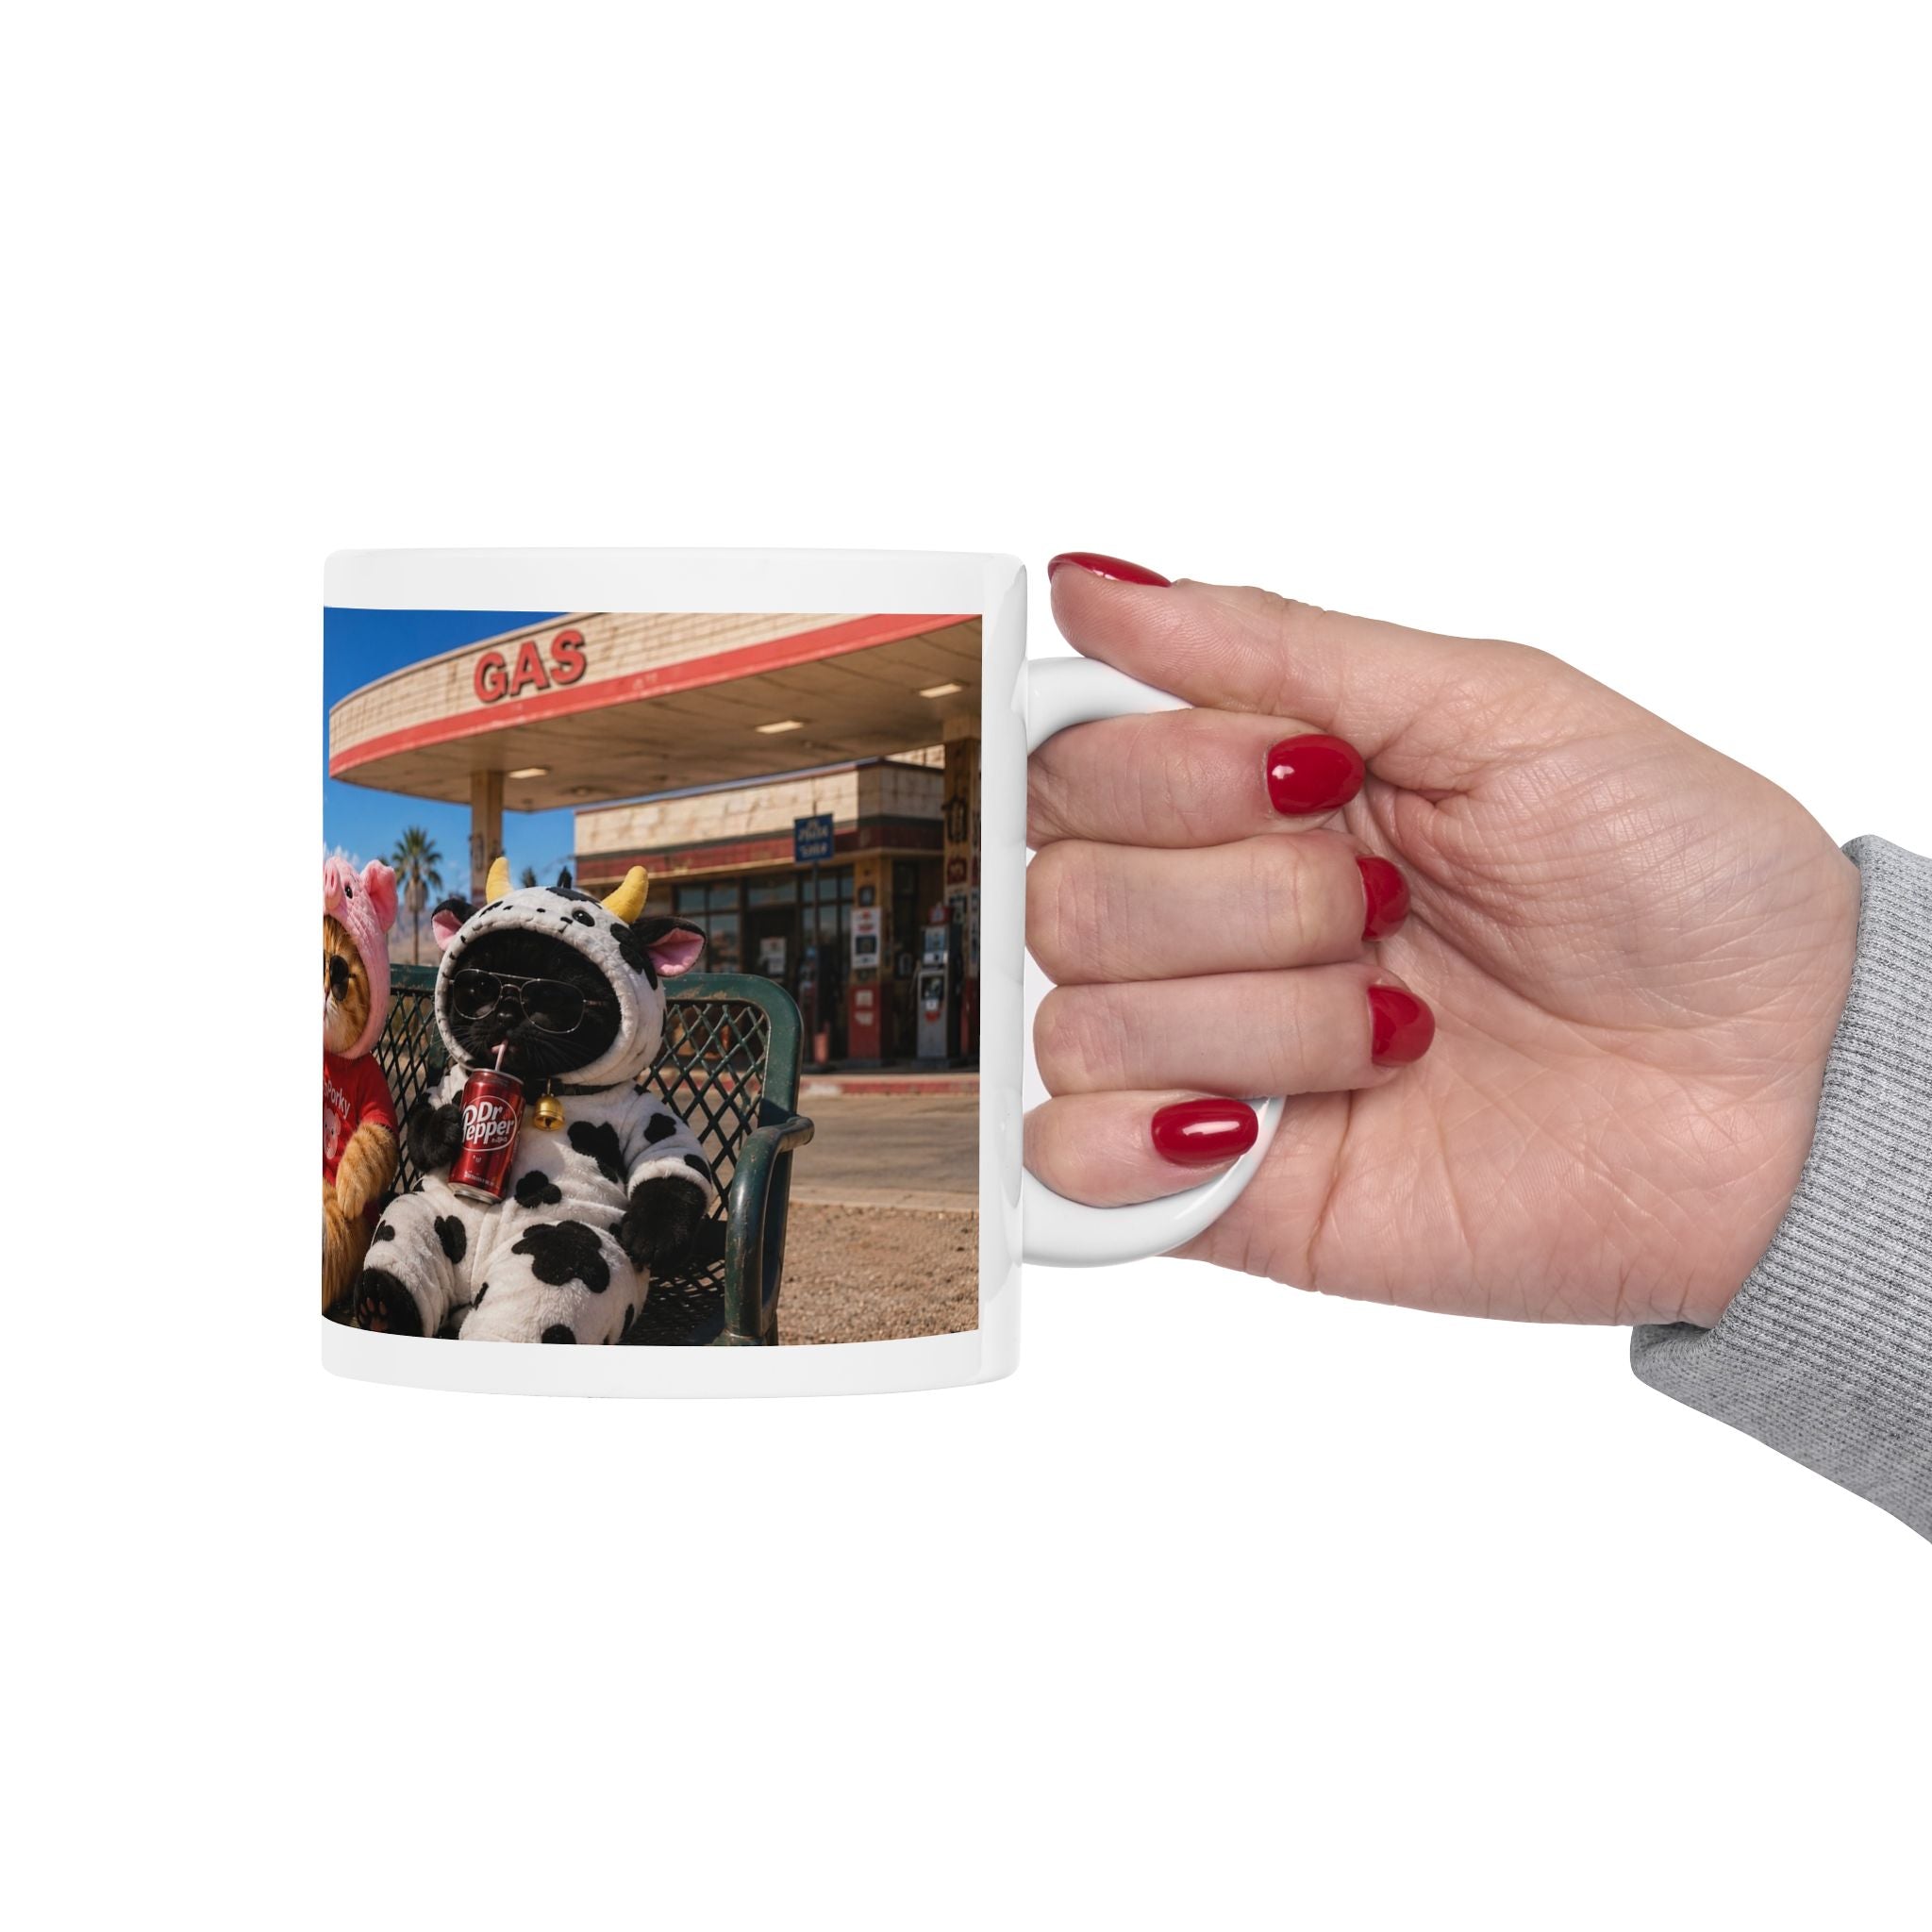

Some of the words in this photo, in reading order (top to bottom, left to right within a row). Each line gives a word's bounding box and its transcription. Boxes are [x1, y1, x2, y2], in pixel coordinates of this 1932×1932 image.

[474, 628, 587, 704] GAS
[462, 1105, 514, 1144] Pepper
[476, 1101, 503, 1123] Dr
